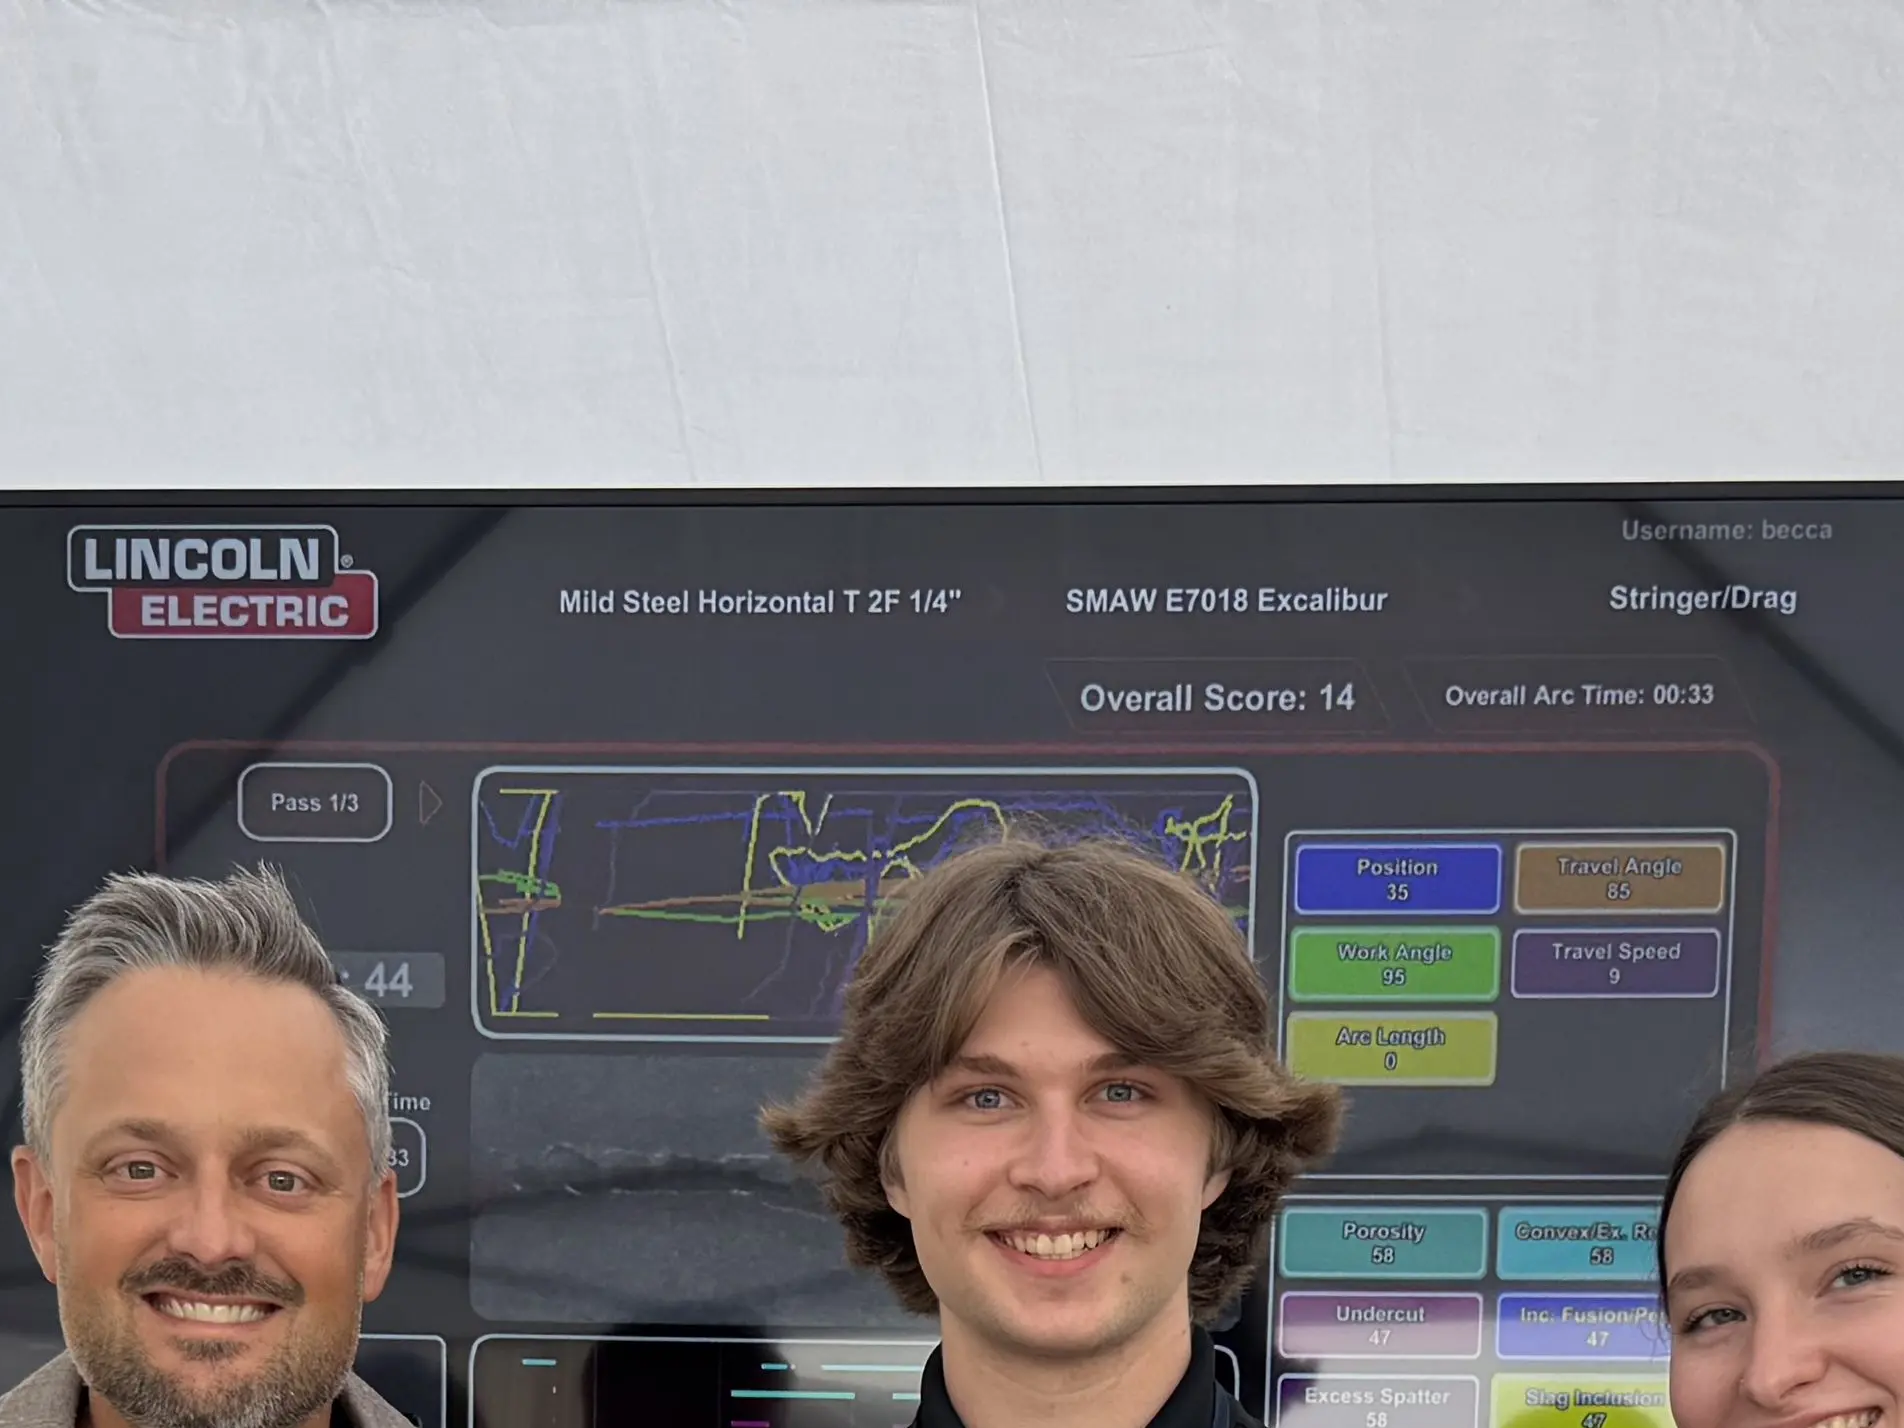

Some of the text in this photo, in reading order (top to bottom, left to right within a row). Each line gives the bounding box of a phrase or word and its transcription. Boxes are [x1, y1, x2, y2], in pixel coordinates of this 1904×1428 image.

[1621, 517, 1832, 541] Username: becca
[84, 538, 322, 582] LINCOLN
[560, 588, 962, 615] Mild Steel Horizontal T 2F 1/4"
[1066, 587, 1387, 614] SMAW E7018 Excalibur
[1609, 584, 1797, 615] Stringer/Drag
[140, 595, 350, 628] ELECTRIC
[1081, 684, 1355, 713] Overall Score: 14
[1445, 683, 1714, 708] Overall Arc Time: 00:33
[270, 790, 358, 814] Pass 1/3
[1357, 857, 1437, 880] Position
[1558, 857, 1682, 881] Travel Angle
[1386, 882, 1409, 900] 35
[1607, 882, 1631, 900] 85
[1338, 942, 1452, 967] Work Angle
[1551, 942, 1680, 966] Travel Speed
[365, 964, 412, 997] 44
[1383, 967, 1406, 986] 95
[1608, 967, 1620, 985] 9
[1336, 1026, 1445, 1052] Arc Length
[1384, 1052, 1397, 1071] 0
[389, 1092, 431, 1110] ime
[1343, 1223, 1425, 1244] Porosity
[1515, 1223, 1628, 1242] Convex/Ex.
[1372, 1247, 1394, 1265] 58
[1590, 1247, 1613, 1265] 58
[1336, 1305, 1425, 1324] Undercut
[1521, 1306, 1554, 1324] Inc.
[1368, 1330, 1391, 1347] 47
[1586, 1331, 1609, 1347] 47
[1305, 1387, 1450, 1409] Excess Spatter
[1525, 1389, 1665, 1410] Slag Inclusion
[1365, 1412, 1388, 1428] 58
